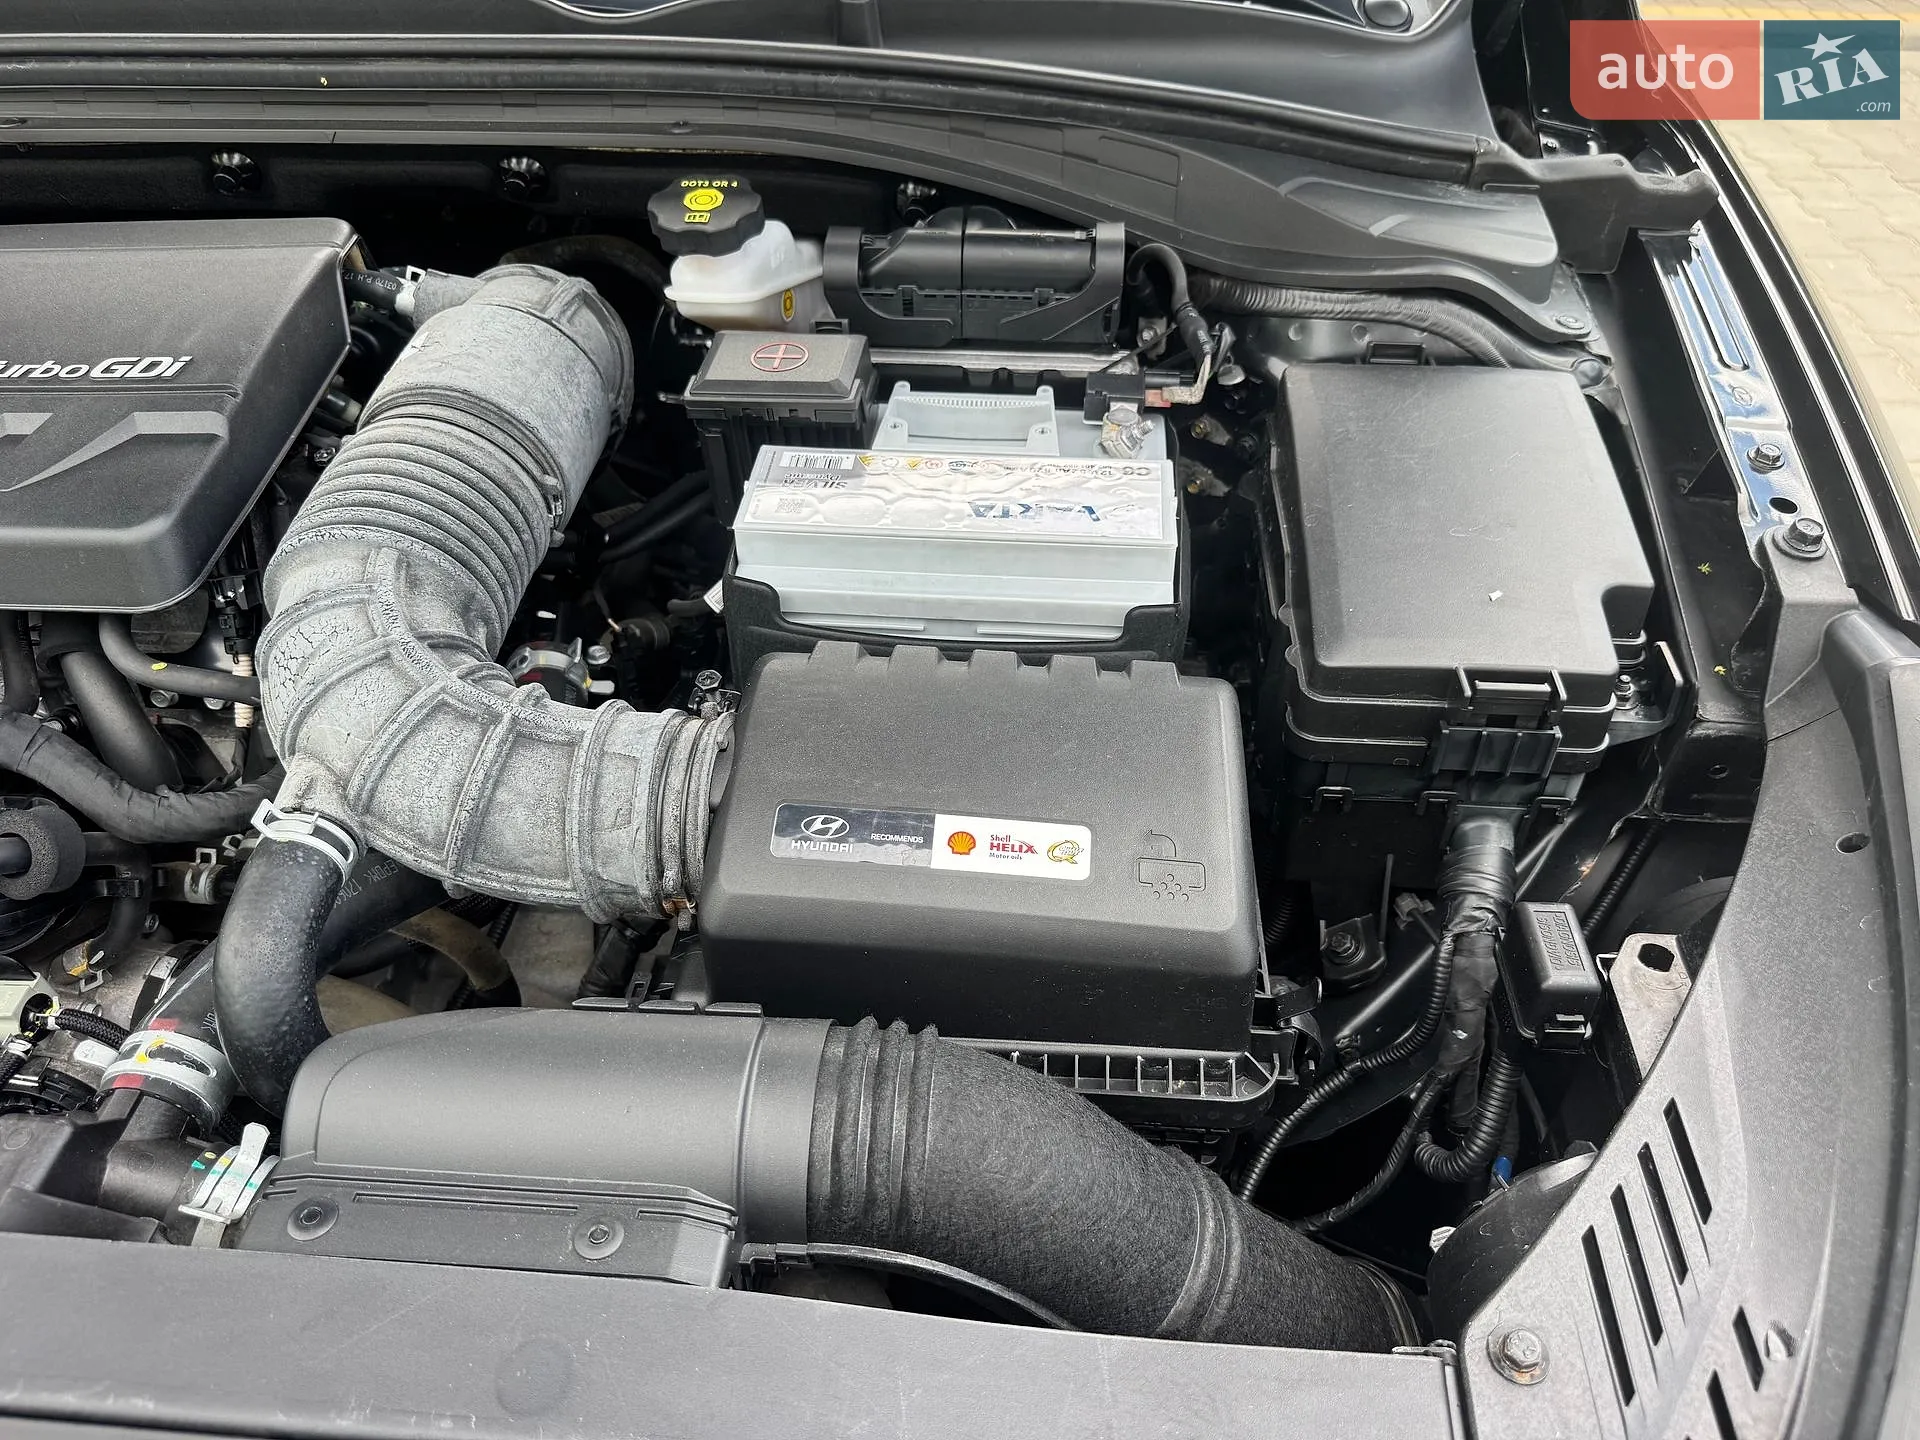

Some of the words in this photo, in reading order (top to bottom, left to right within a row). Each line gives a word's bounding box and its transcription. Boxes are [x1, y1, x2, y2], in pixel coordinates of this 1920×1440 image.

[680, 180, 709, 188] DOT3
[712, 180, 729, 188] OR
[731, 180, 738, 188] 4
[791, 839, 854, 853] HYUNDAI
[870, 832, 924, 844] RECOMMENDS
[990, 834, 1011, 843] Shell
[989, 842, 1037, 855] HELIX
